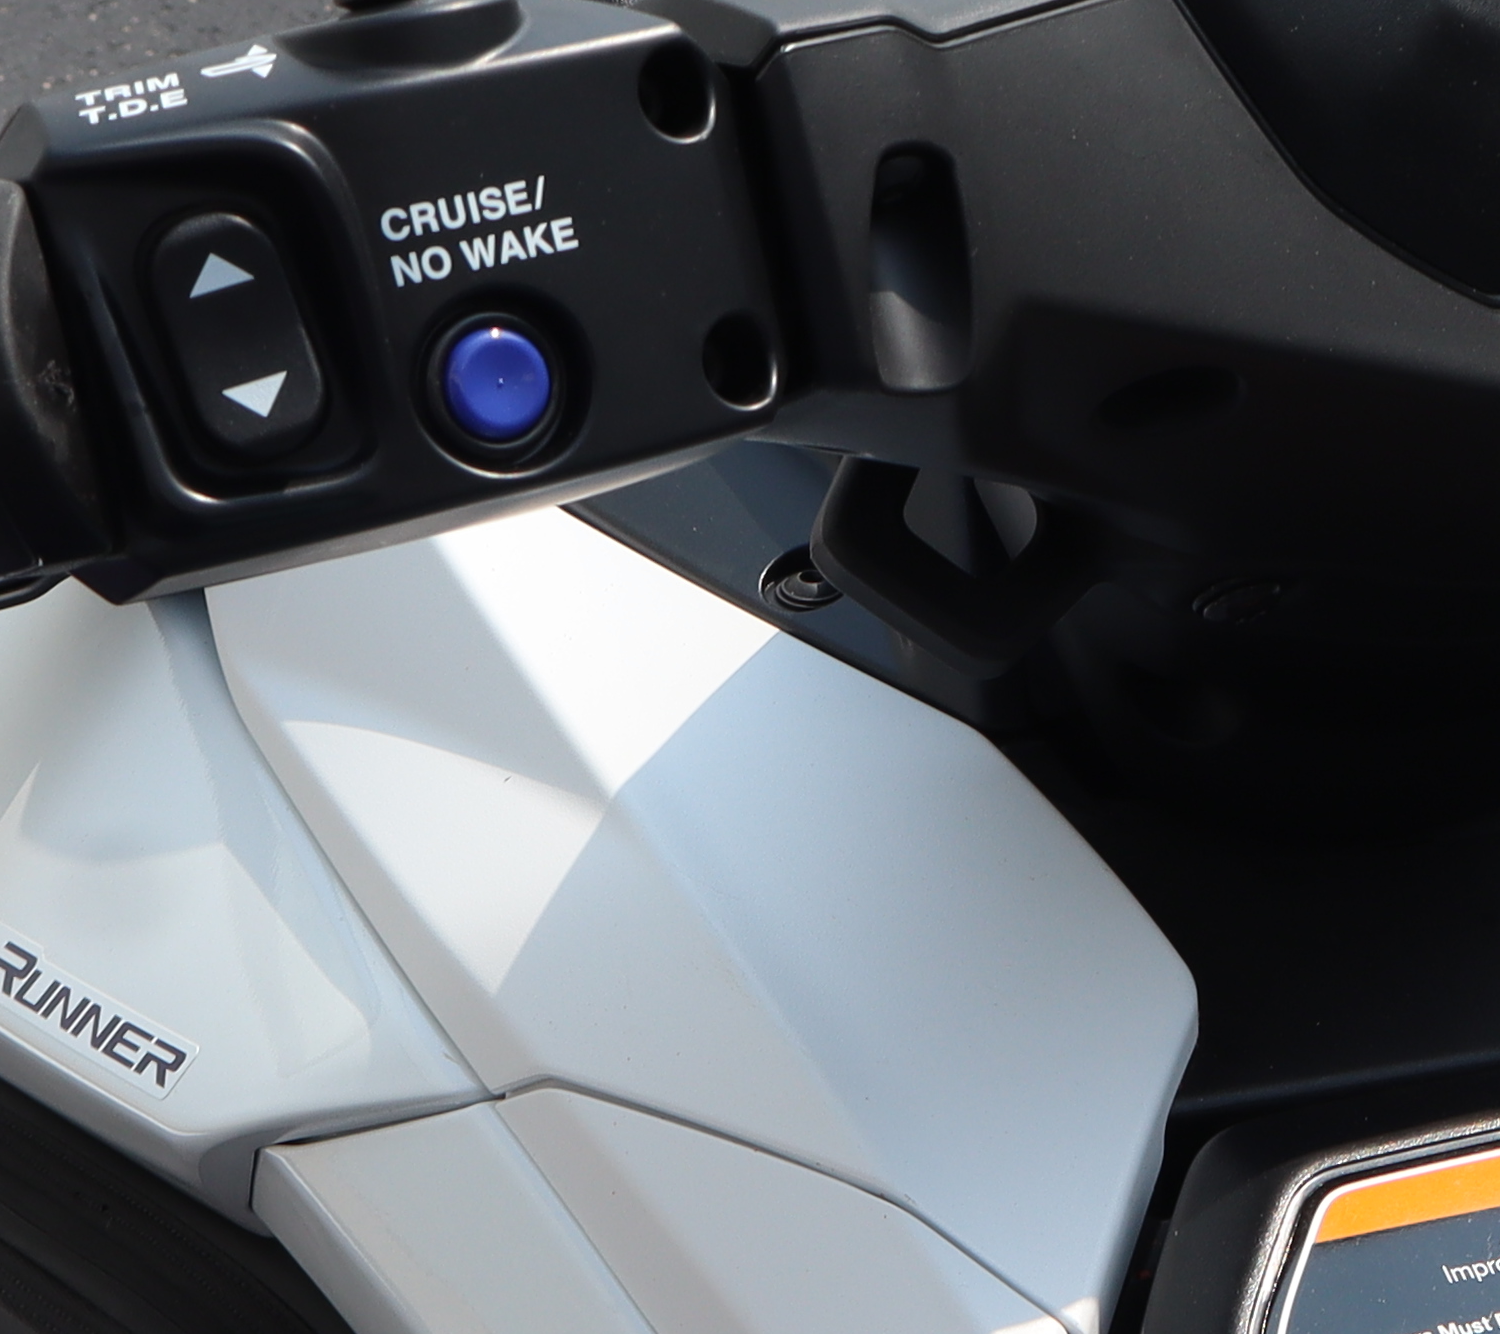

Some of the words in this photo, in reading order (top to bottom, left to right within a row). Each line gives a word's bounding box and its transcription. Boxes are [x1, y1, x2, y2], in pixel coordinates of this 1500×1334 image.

[74, 72, 181, 108] TRIM
[79, 88, 189, 126] T.D.E
[380, 176, 547, 243] CRUISE/
[390, 244, 453, 289] NO
[461, 217, 580, 272] WAKE
